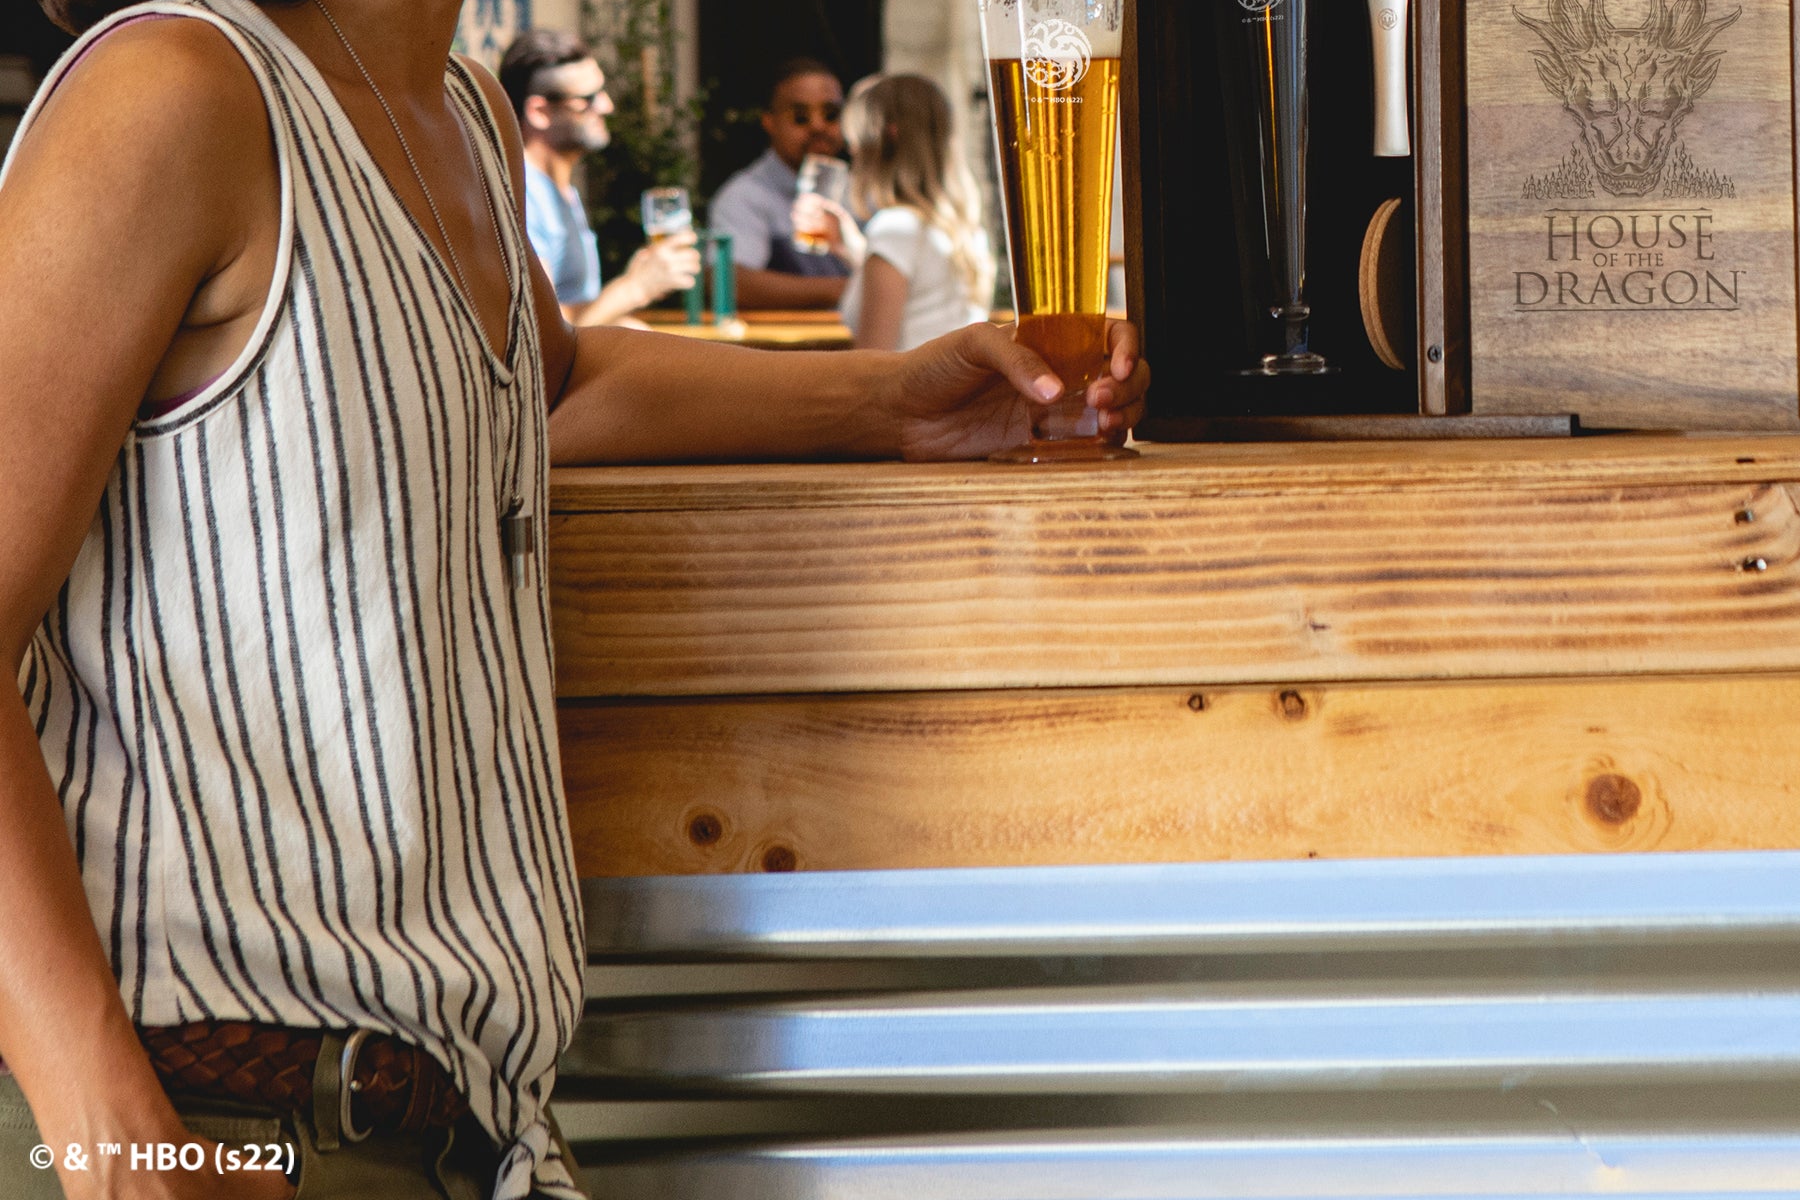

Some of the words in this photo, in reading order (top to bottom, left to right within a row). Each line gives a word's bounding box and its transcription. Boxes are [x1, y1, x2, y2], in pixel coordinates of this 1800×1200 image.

[1544, 214, 1715, 262] HOUSE
[1593, 253, 1618, 267] OF
[1624, 253, 1664, 267] THE
